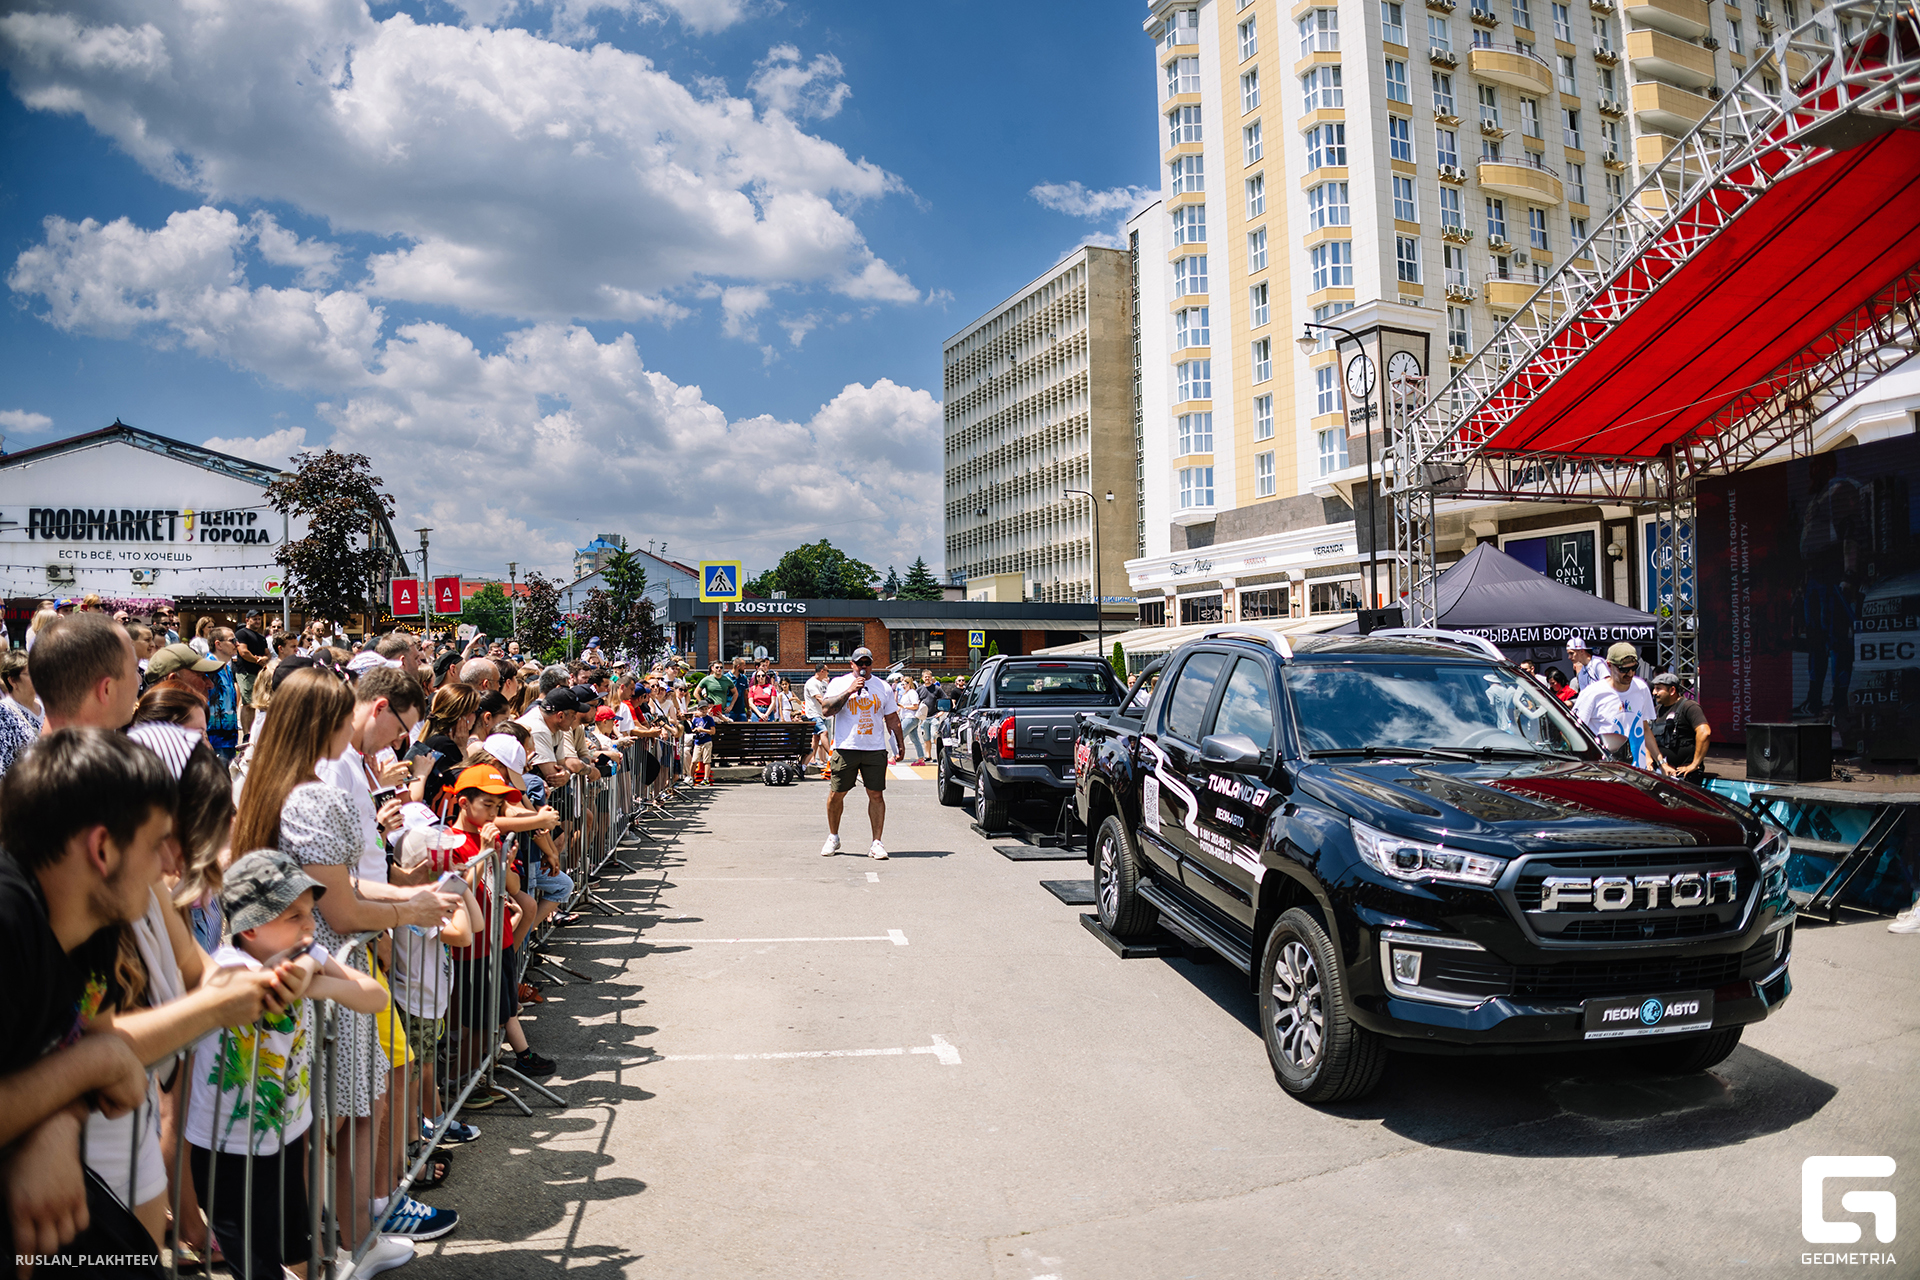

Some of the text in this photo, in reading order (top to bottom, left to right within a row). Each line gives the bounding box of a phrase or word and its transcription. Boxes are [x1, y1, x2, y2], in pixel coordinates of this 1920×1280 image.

[28, 507, 179, 541] FOODMARKET
[200, 511, 258, 527] ЦЕНТР
[200, 528, 270, 544] ГОРОДА
[58, 550, 87, 560] ЕСТЬ
[119, 551, 141, 561] ЧТО
[143, 551, 193, 562] ХОЧЕШЬ
[1556, 566, 1585, 578] ONLY
[1731, 575, 1739, 591] НА
[734, 603, 807, 613] ROSTIC'S
[1743, 605, 1751, 628] РАЗ
[1543, 626, 1595, 642] ВОРОТА
[1600, 627, 1608, 641] В
[1611, 626, 1655, 641] СПОРТ
[1731, 593, 1740, 676] АВТОМОБИЛЯ
[1860, 641, 1915, 661] ВЕС
[1743, 631, 1751, 712] КОЛИЧЕСТВО
[1208, 773, 1270, 808] TUNLAND G7
[1541, 868, 1738, 912] FOTON
[1602, 1000, 1700, 1022] ЛЕОН АВТО
